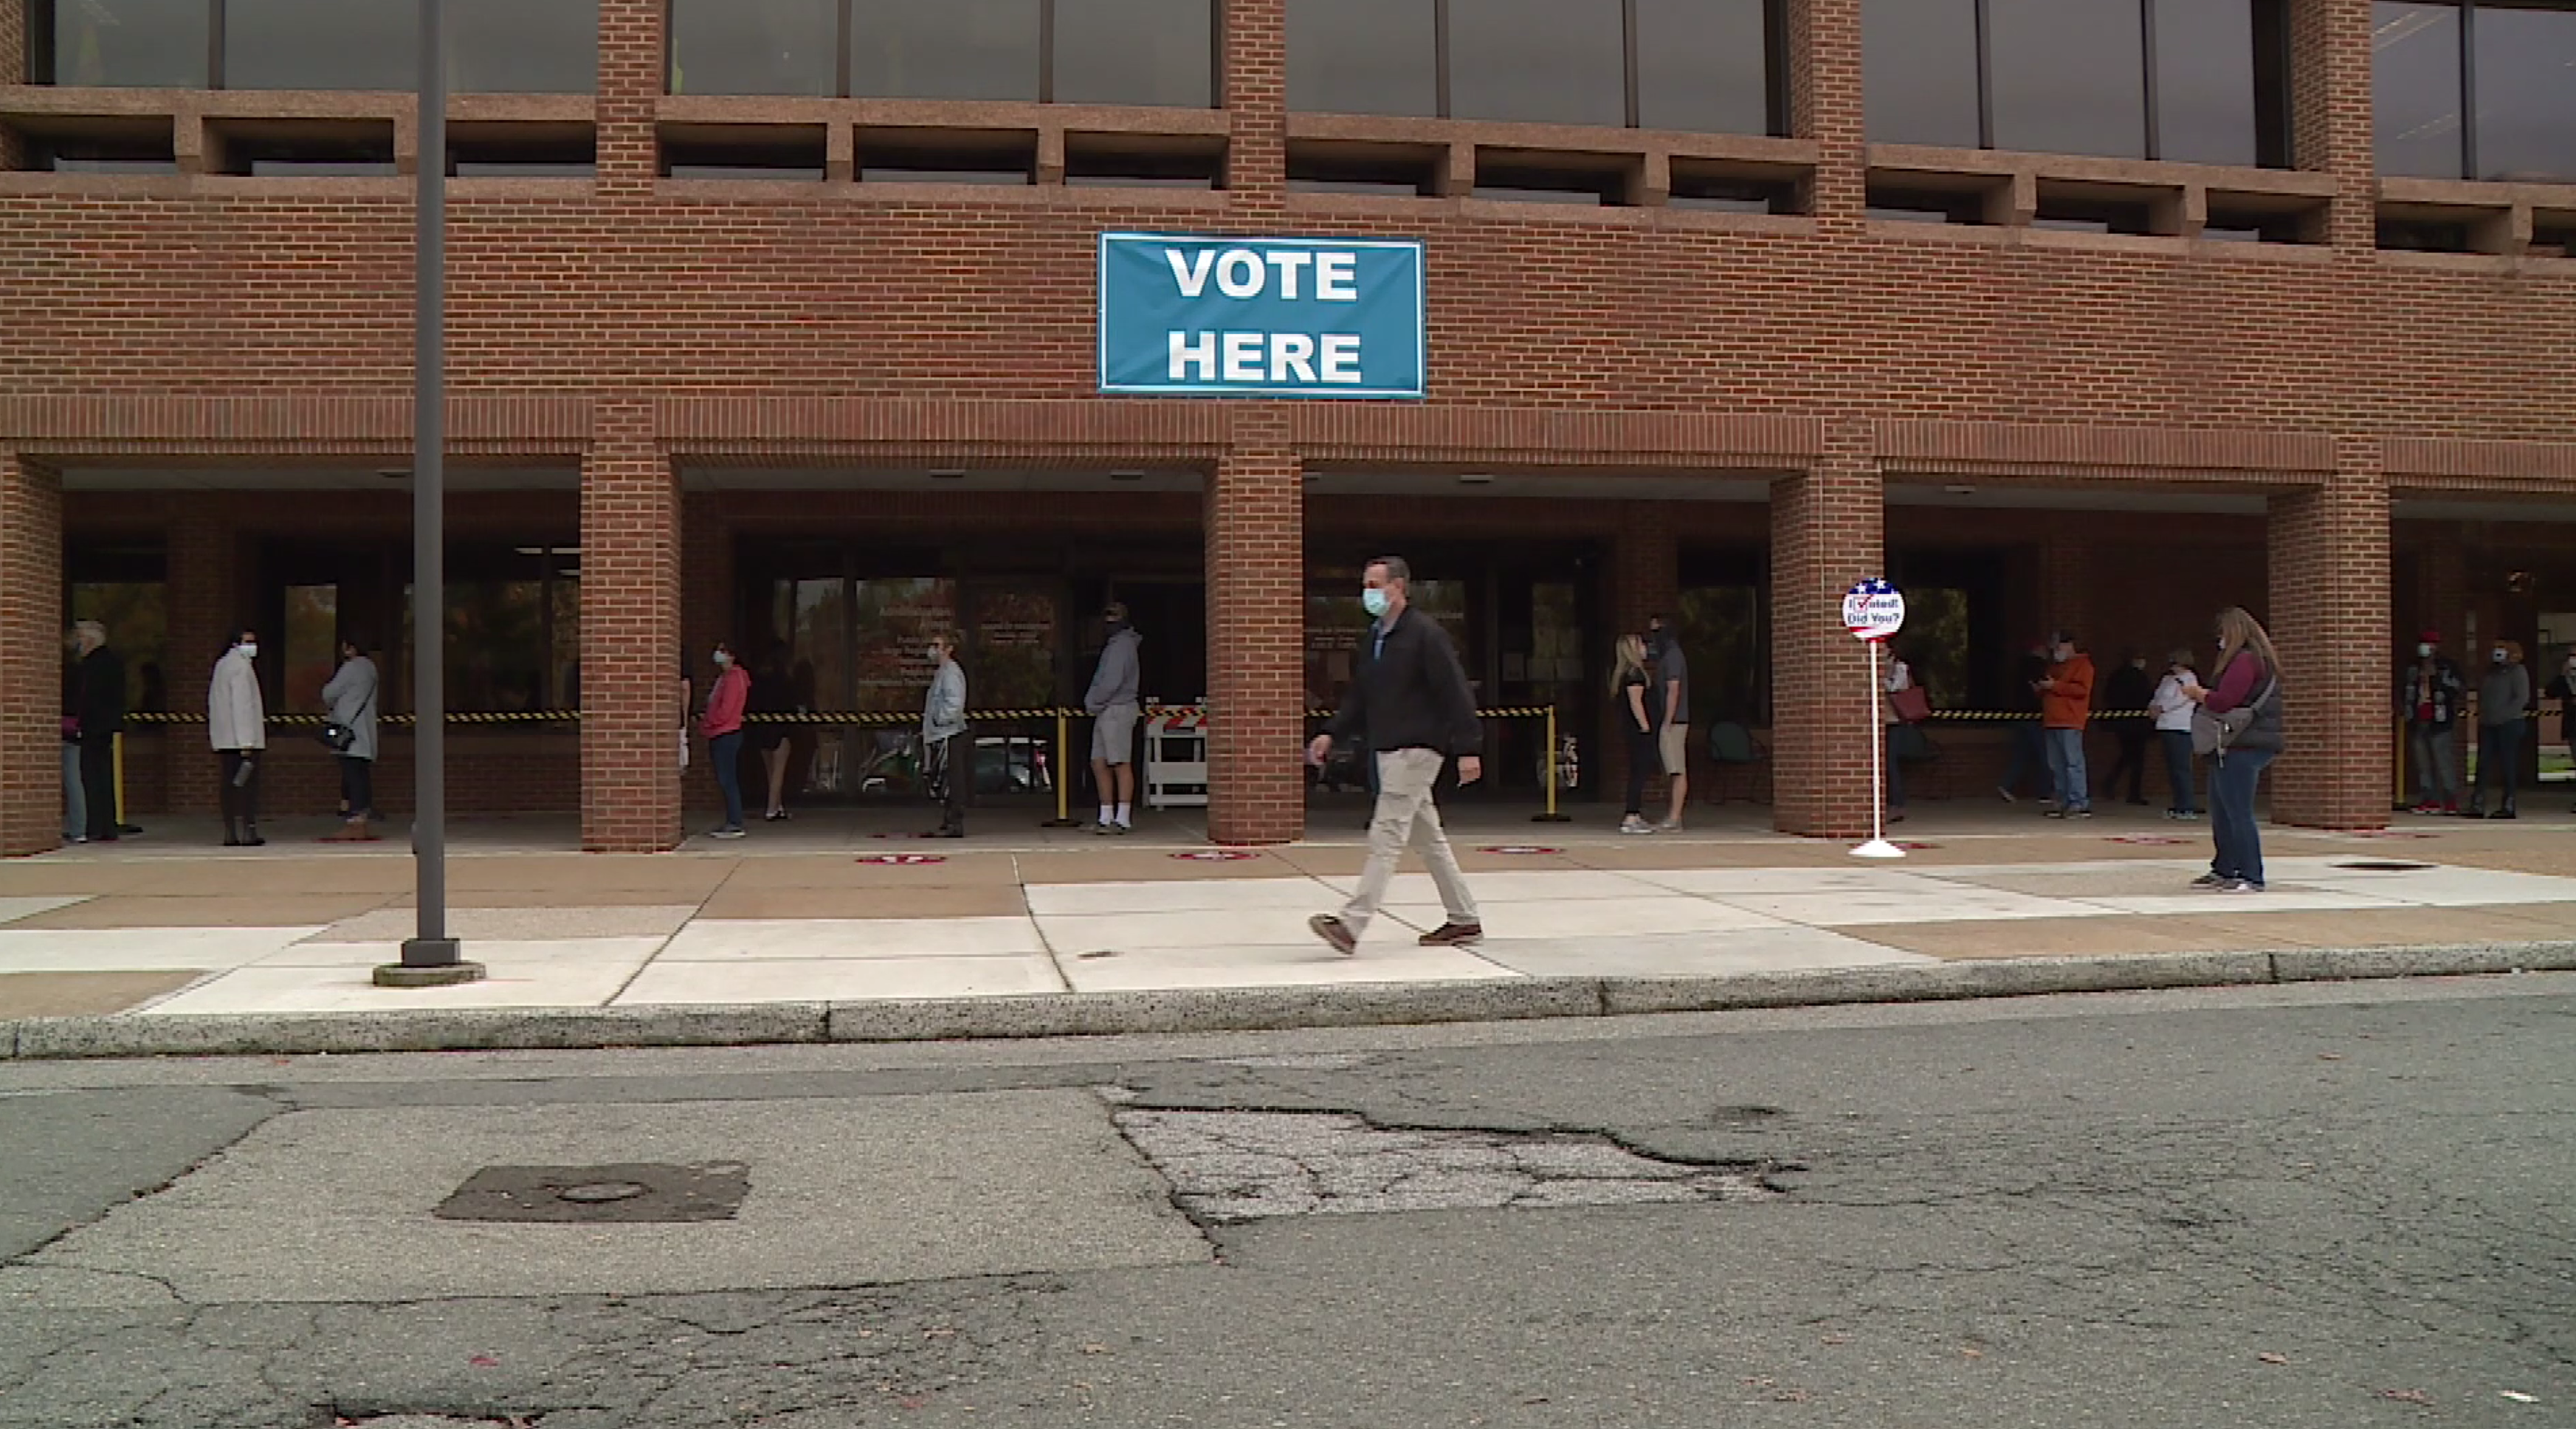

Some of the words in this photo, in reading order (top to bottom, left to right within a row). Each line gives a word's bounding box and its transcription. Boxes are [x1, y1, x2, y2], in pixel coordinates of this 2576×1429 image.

[1165, 249, 1357, 300] VOTE
[1168, 331, 1361, 383] HERE
[1847, 613, 1867, 624] Did
[1870, 613, 1900, 624] You?
